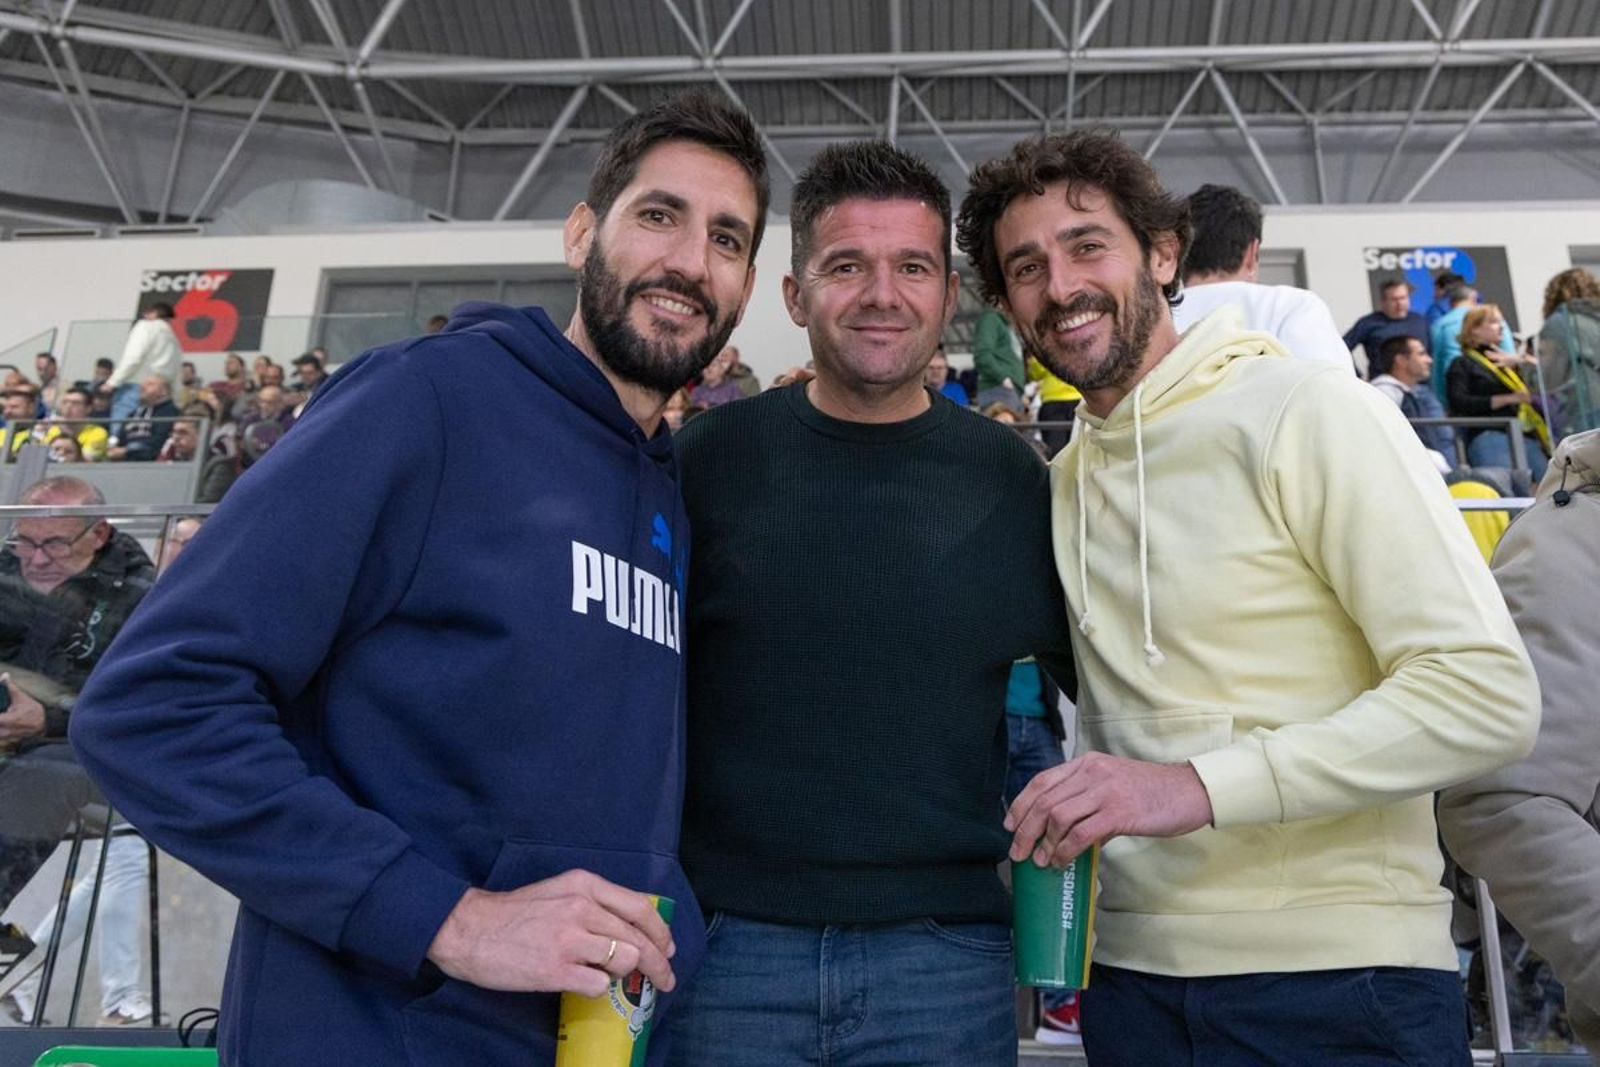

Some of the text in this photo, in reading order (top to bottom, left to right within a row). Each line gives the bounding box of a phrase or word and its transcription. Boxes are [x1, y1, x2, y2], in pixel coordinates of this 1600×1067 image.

[1363, 249, 1457, 270] Sector
[140, 270, 228, 292] Sector
[171, 268, 238, 353] 6
